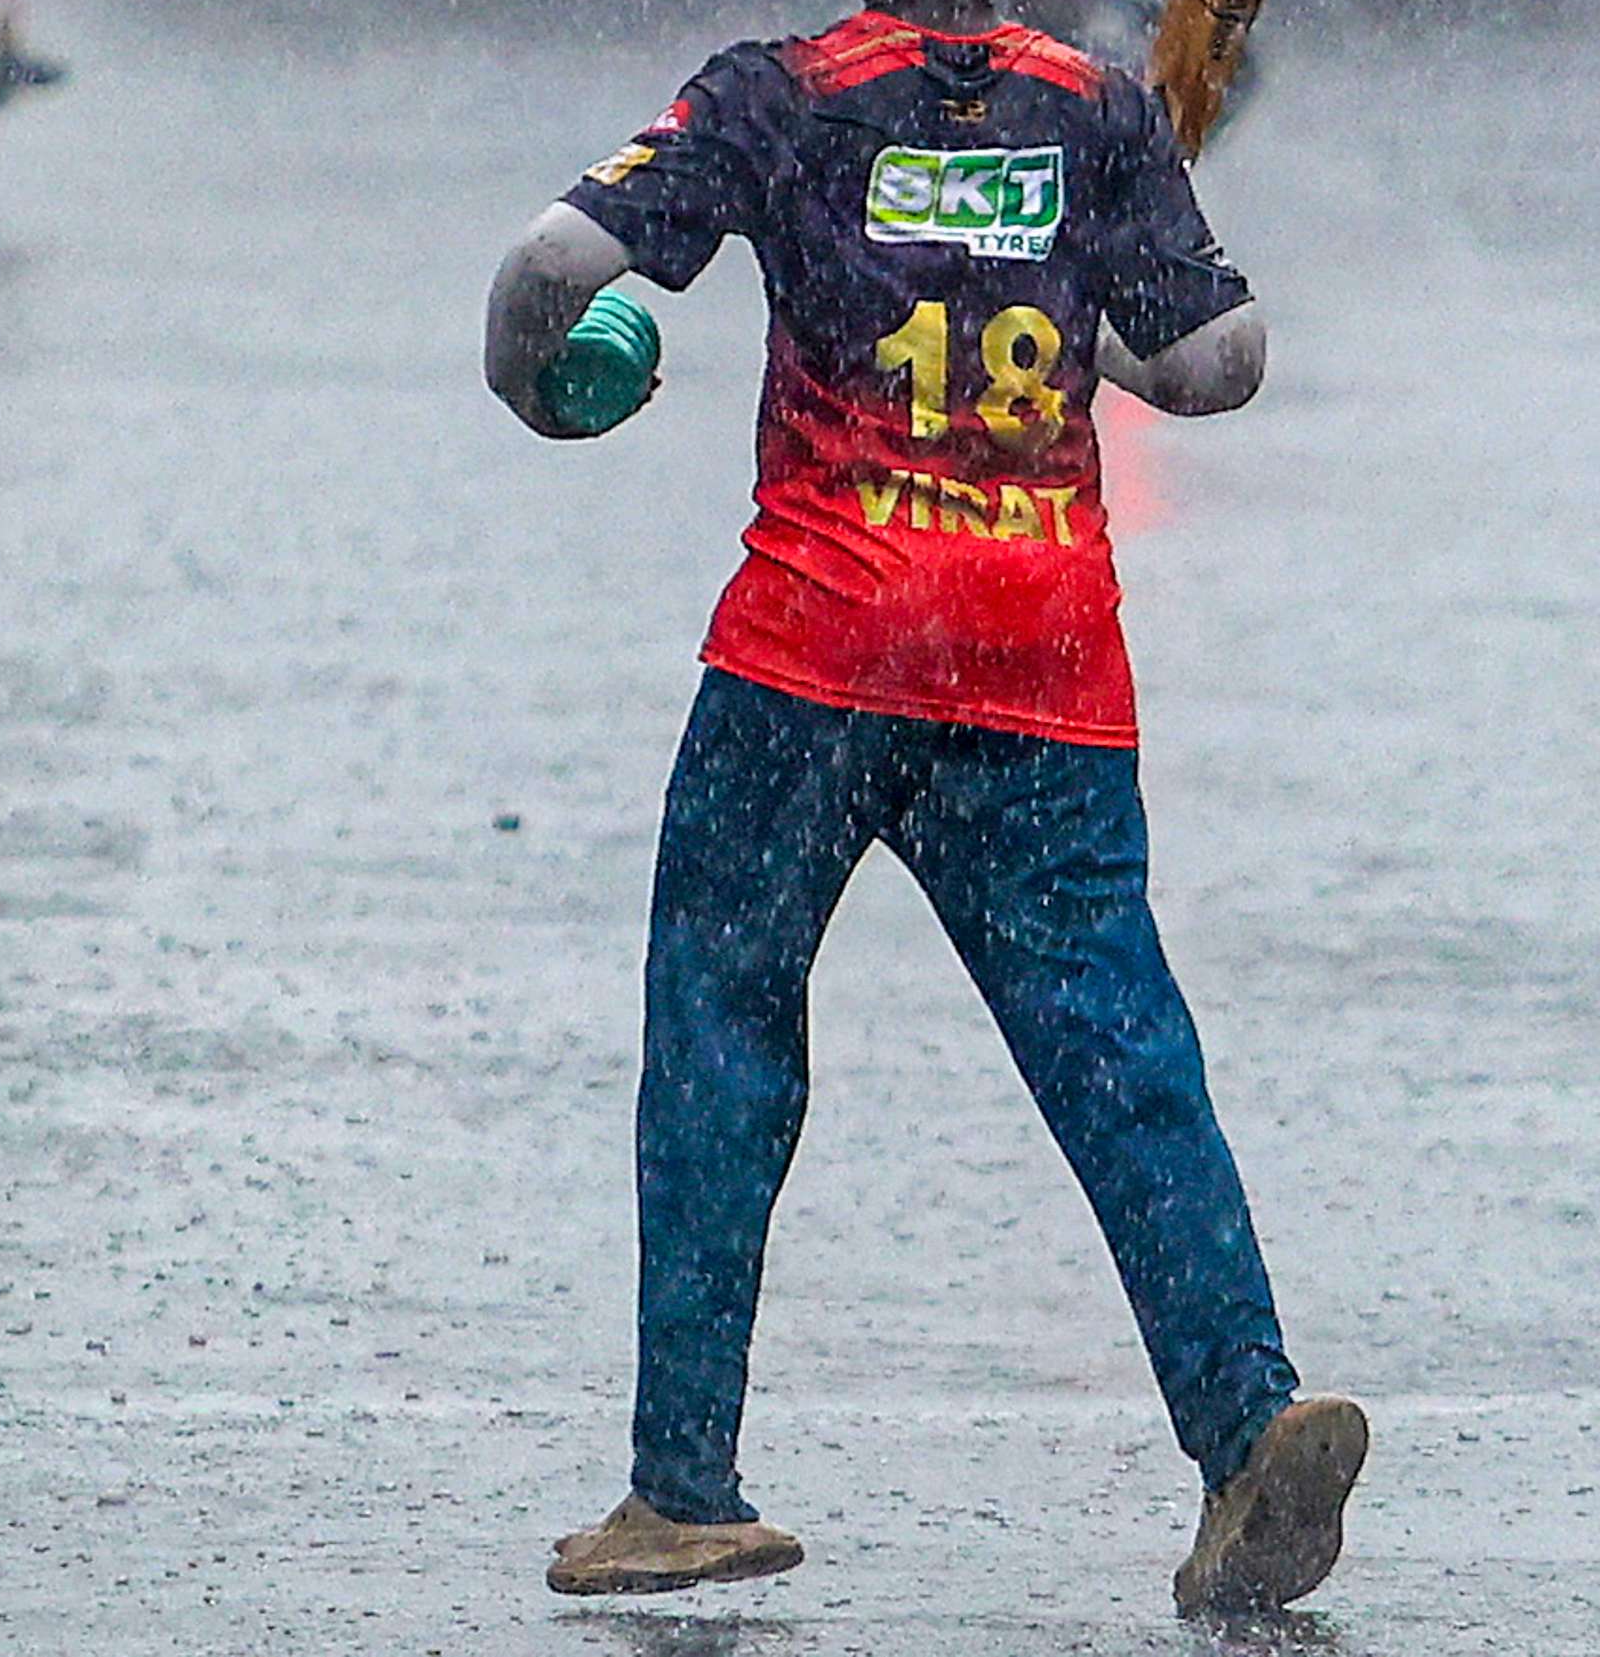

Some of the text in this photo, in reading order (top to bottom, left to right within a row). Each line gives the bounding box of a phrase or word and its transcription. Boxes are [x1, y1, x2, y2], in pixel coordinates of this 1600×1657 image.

[877, 162, 1056, 217] BKT
[875, 299, 1067, 451] 18
[856, 469, 1079, 549] VIRAT
